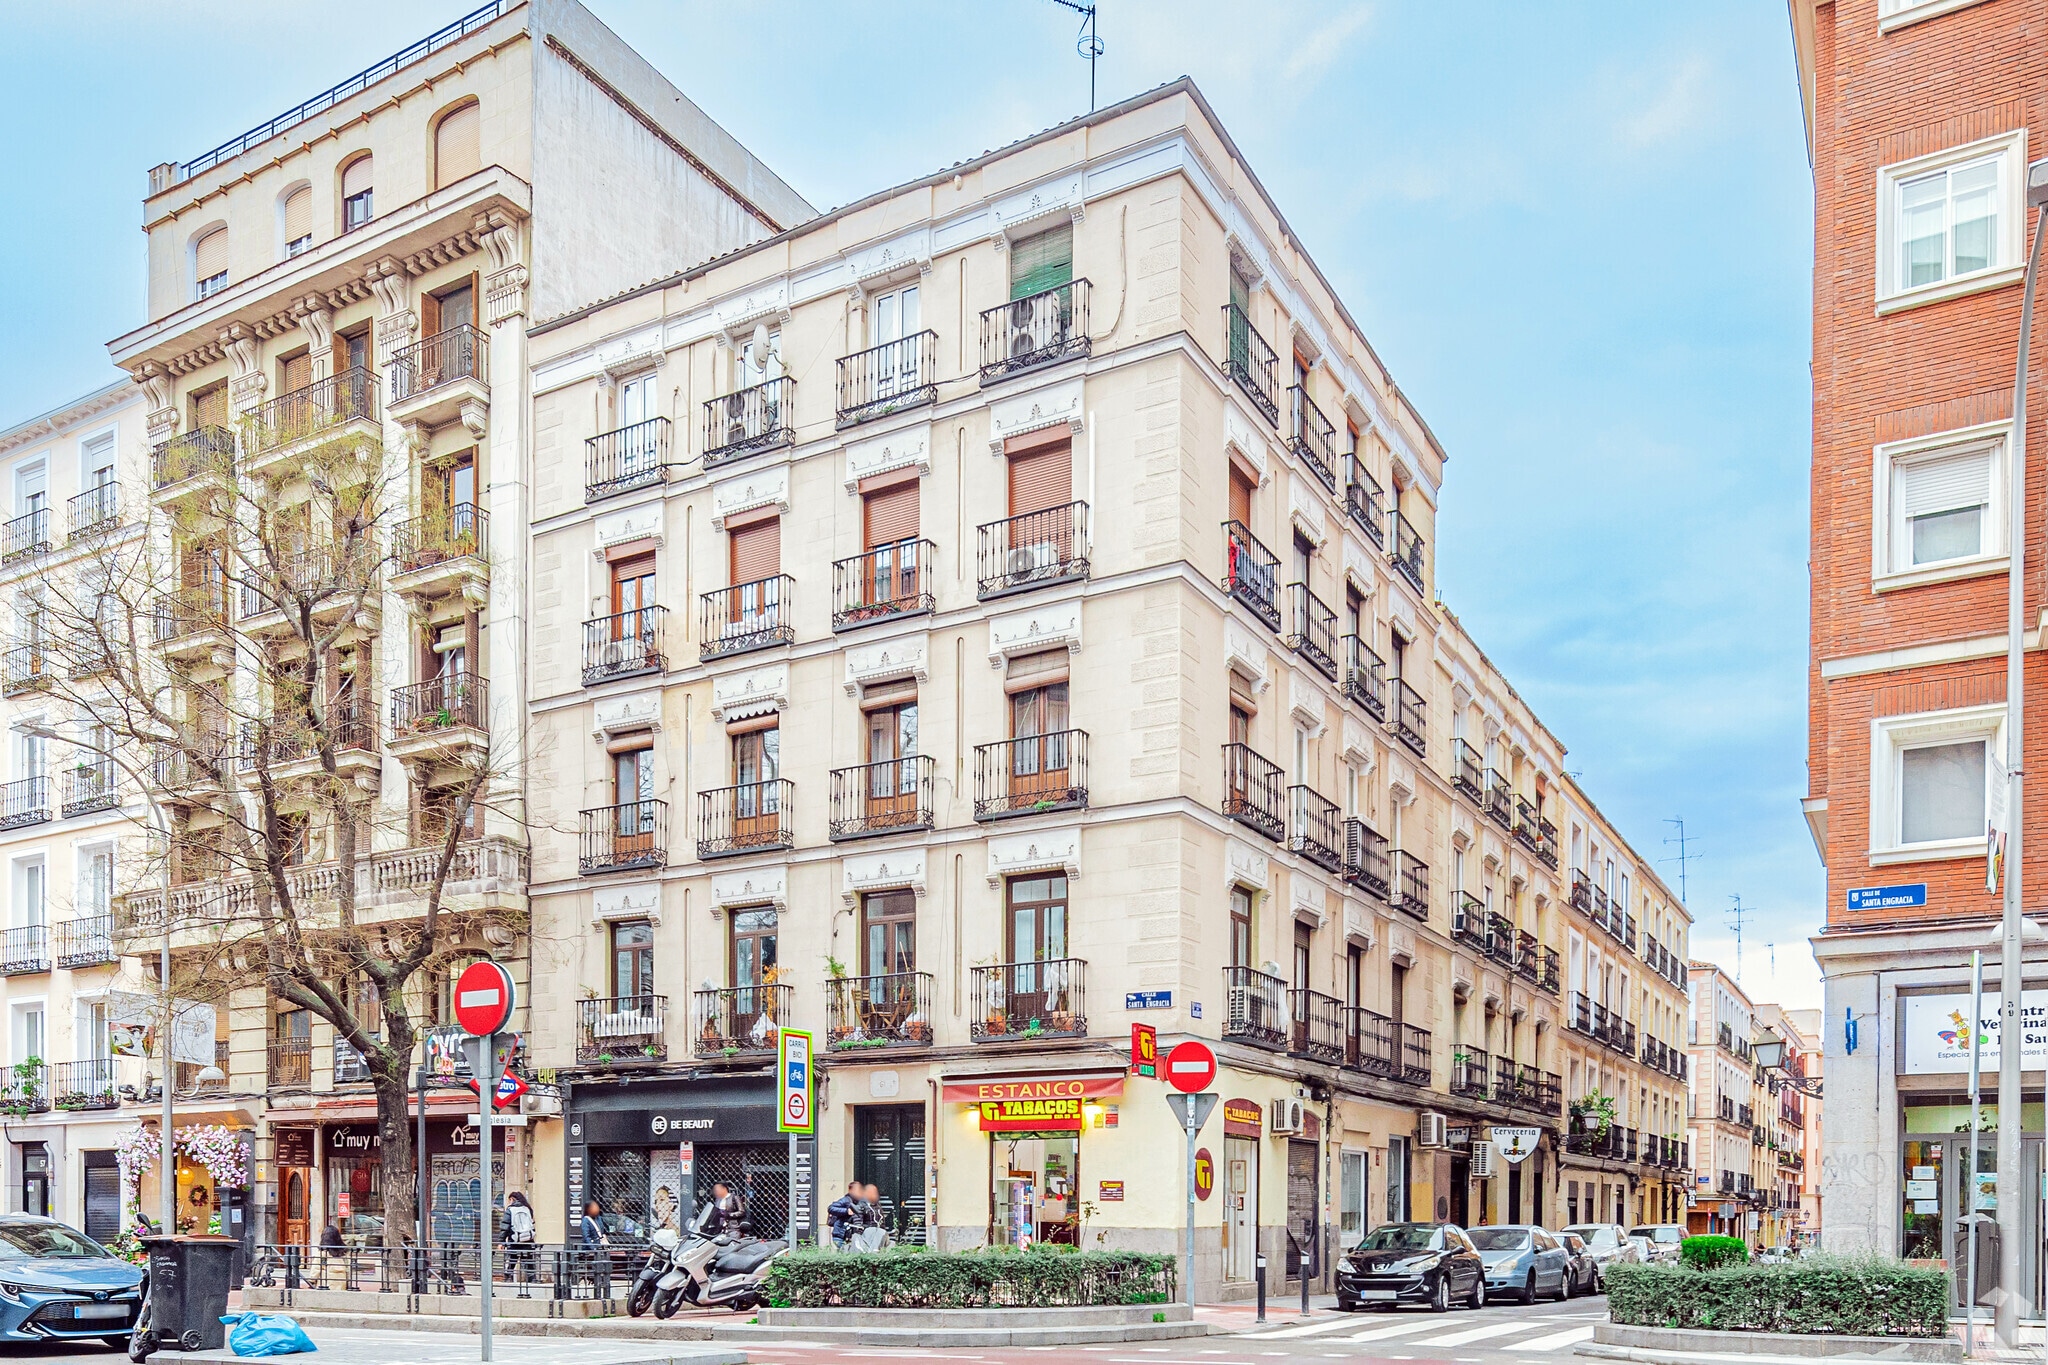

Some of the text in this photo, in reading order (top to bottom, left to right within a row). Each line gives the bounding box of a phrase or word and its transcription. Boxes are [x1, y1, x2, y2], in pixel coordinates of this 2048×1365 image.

[1862, 896, 1914, 907] SANTA ENGRACIA
[788, 1039, 806, 1049] CARRIL
[978, 1081, 1085, 1099] ESTANCO
[1003, 1100, 1079, 1115] TABACOS
[1232, 1108, 1259, 1120] TABACOS
[671, 1120, 682, 1129] BE
[683, 1119, 715, 1129] BEAUTY
[346, 1135, 371, 1150] muy
